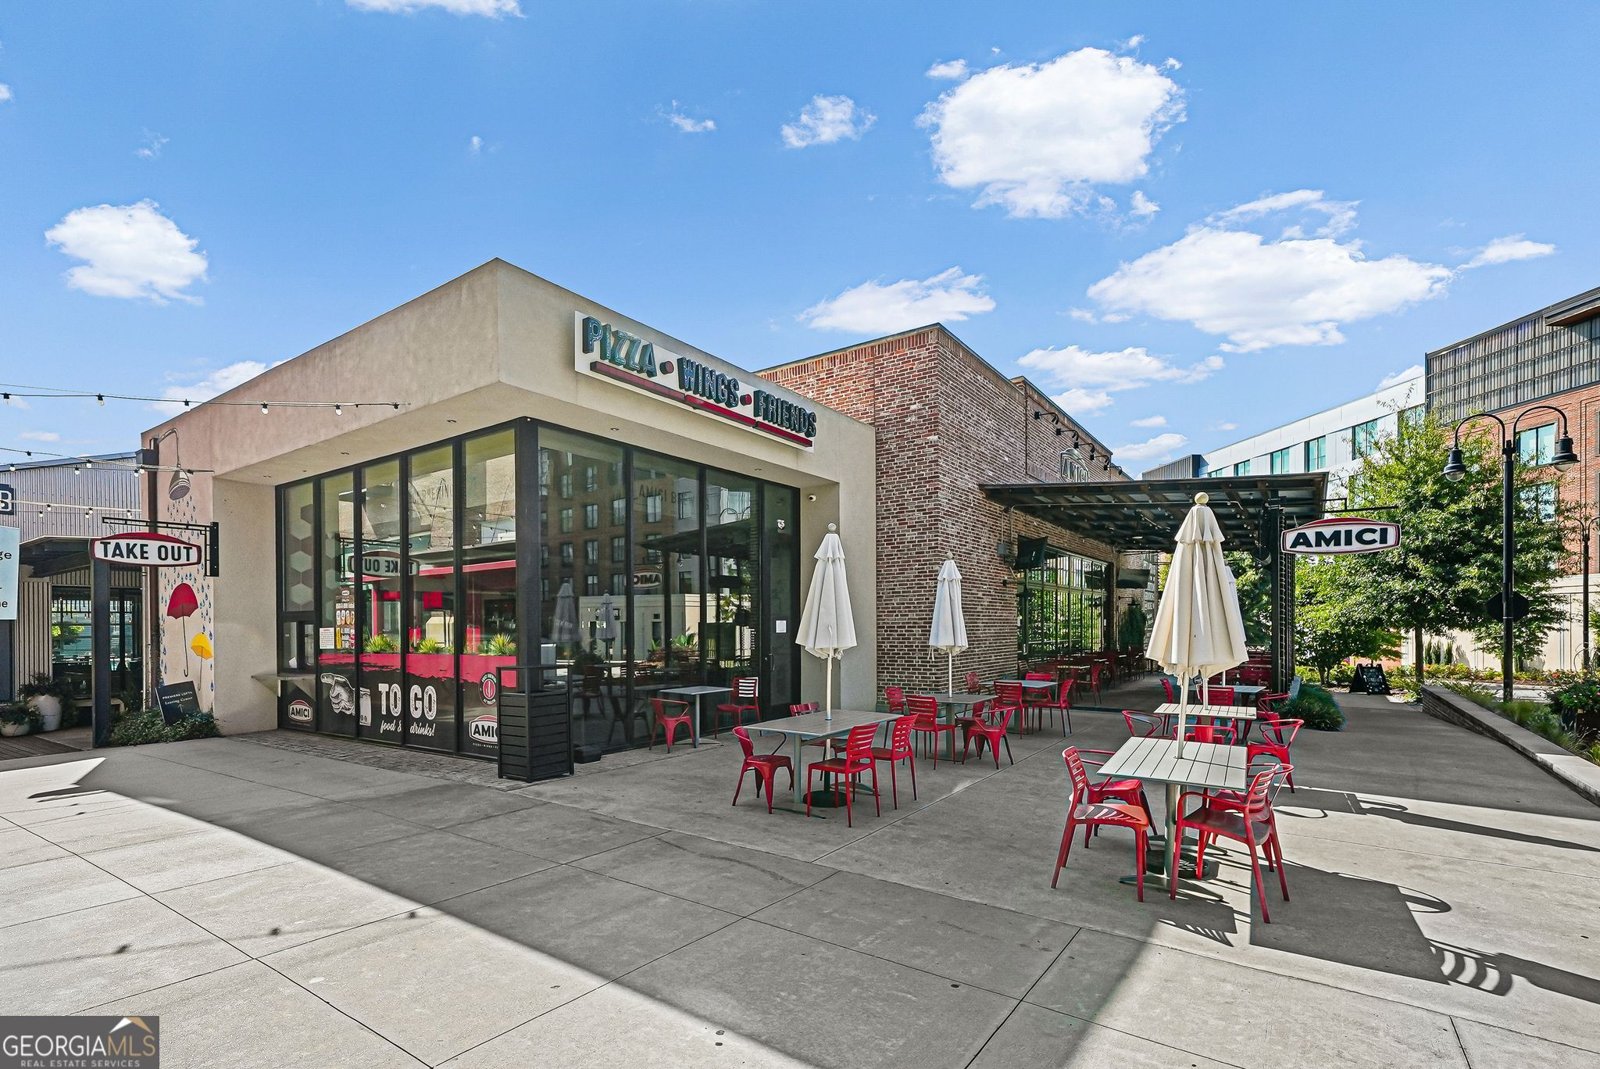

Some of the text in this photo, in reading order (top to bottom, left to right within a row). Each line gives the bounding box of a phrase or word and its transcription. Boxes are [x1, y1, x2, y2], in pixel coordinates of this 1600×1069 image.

[582, 316, 817, 438] PIZZA WINGS FRIENDS
[1290, 527, 1388, 549] AMICI
[100, 541, 193, 562] TAKE OUT
[290, 706, 310, 718] AMICI
[378, 683, 437, 720] TO GO
[380, 720, 396, 734] food
[410, 722, 435, 737] drinks!
[473, 723, 498, 738] AMI
